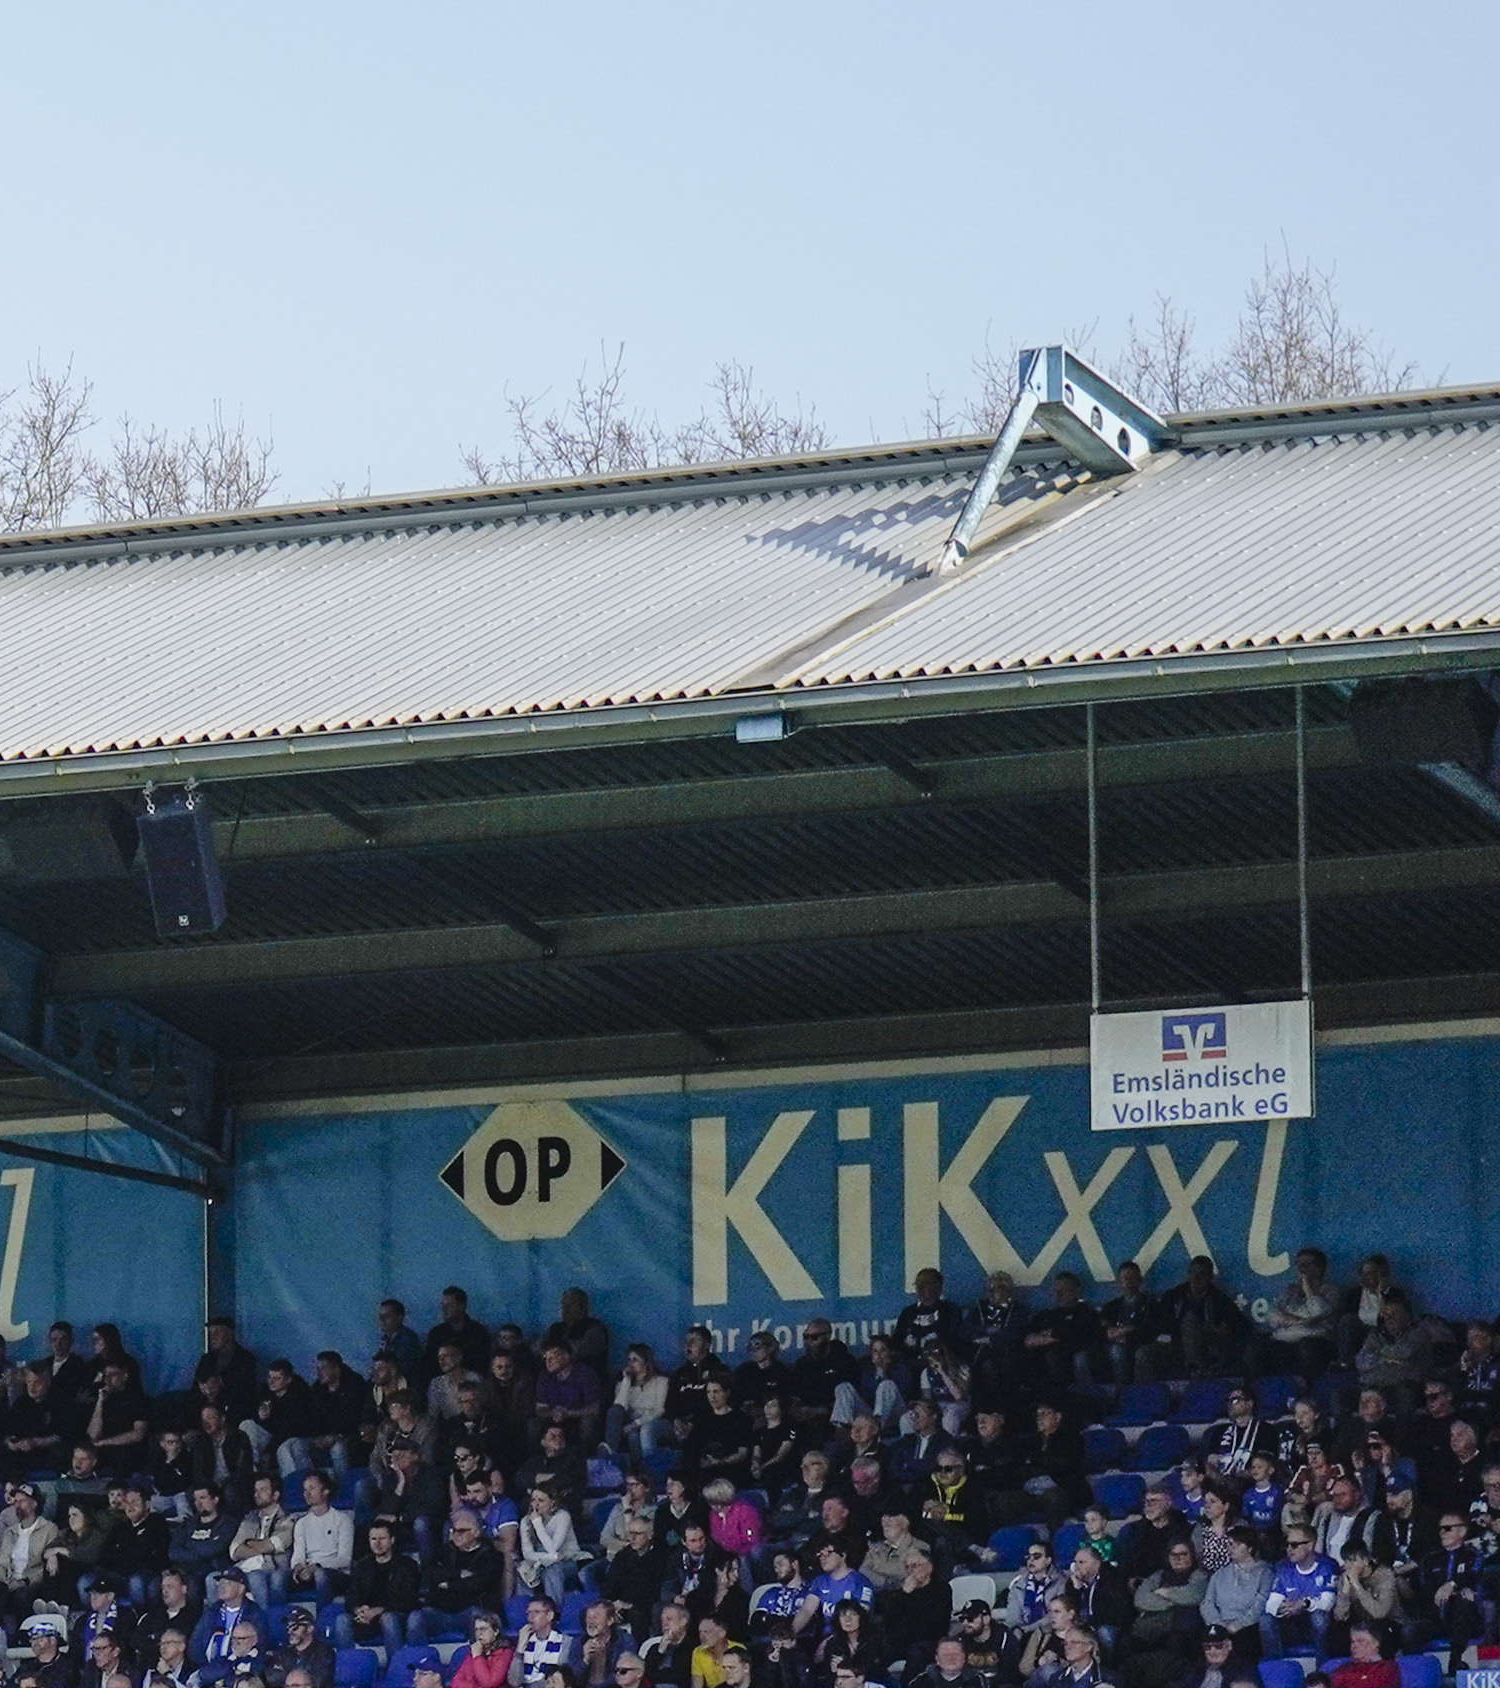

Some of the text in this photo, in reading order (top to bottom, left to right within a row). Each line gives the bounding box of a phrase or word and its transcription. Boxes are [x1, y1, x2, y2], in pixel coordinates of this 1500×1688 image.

[1112, 1062, 1288, 1095] Emsländische
[1112, 1089, 1288, 1121] Volksbank eG
[486, 1135, 571, 1206] OP
[690, 1092, 1293, 1308] KiKxxl
